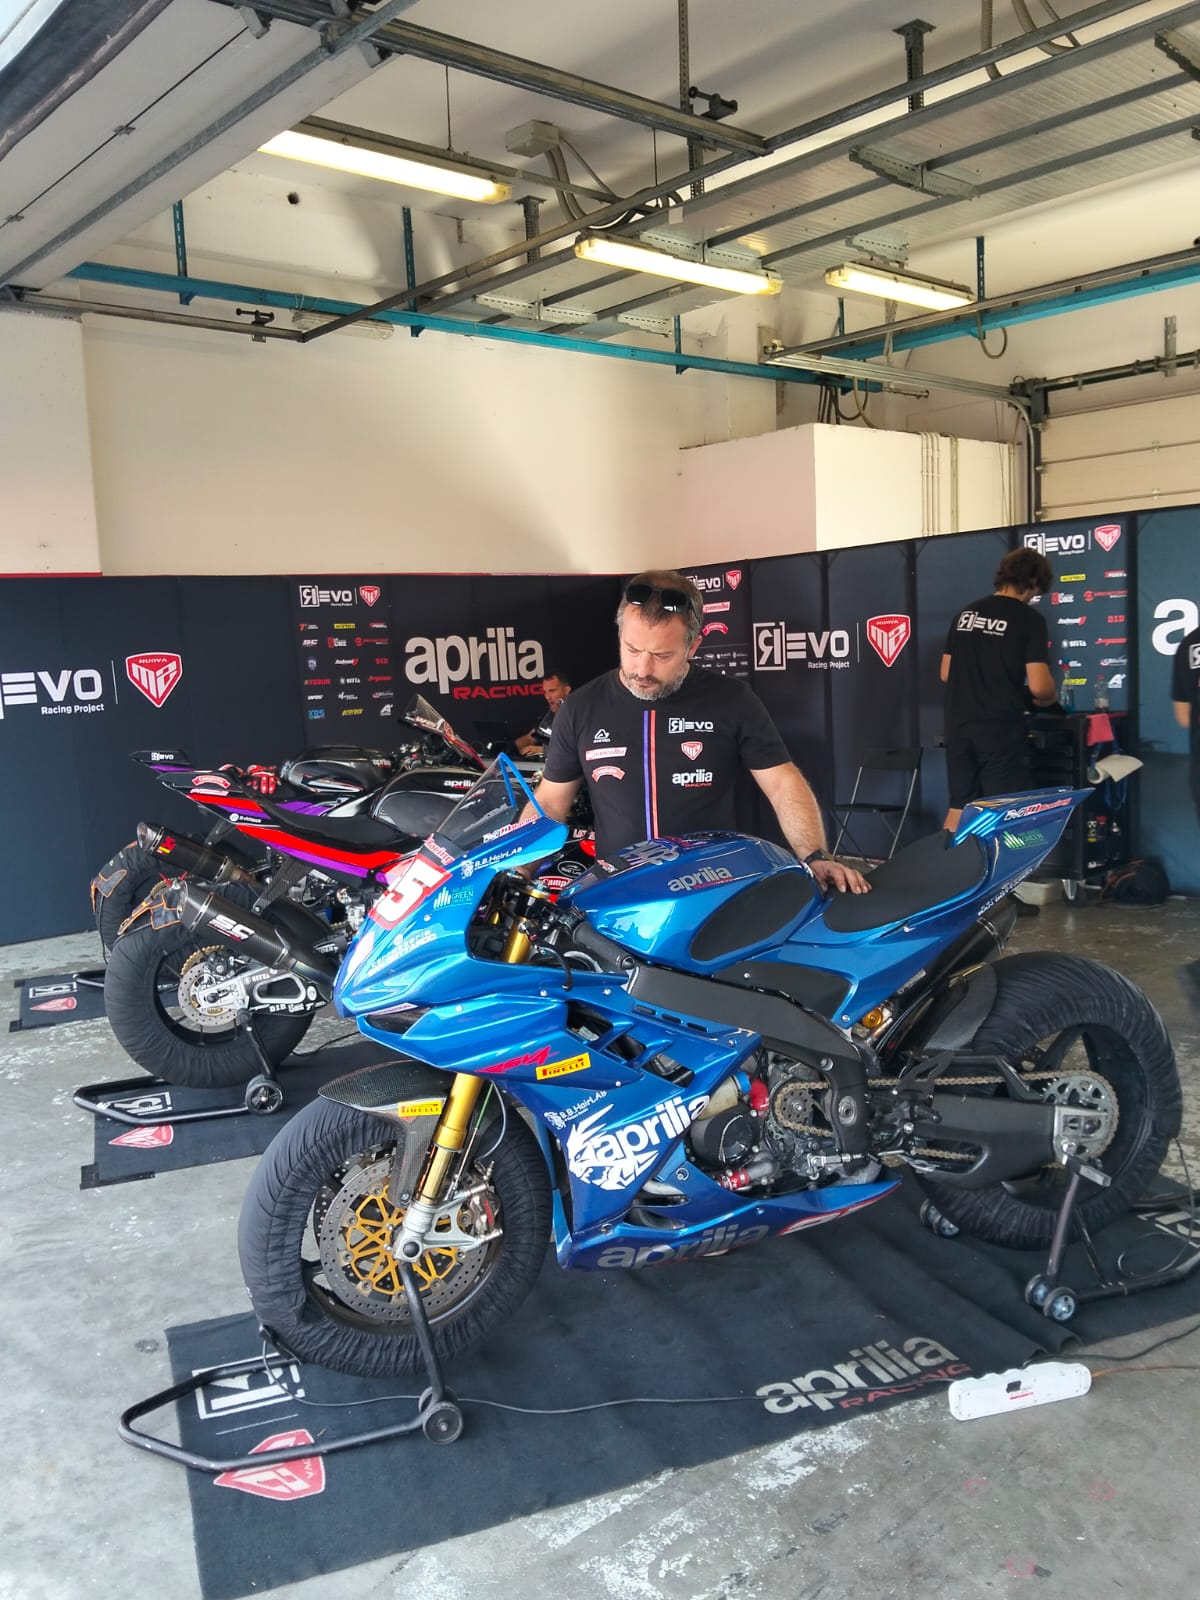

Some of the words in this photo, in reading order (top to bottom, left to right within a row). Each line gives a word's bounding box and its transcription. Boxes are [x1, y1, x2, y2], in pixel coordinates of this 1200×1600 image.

[405, 627, 545, 694] aprilia
[829, 661, 850, 669] Project
[1, 669, 103, 706] EVO
[453, 683, 545, 700] RACING
[41, 704, 73, 715] Racing
[74, 703, 105, 714] Project
[672, 769, 713, 787] aprilia
[667, 866, 733, 892] aprilia
[541, 1058, 585, 1076] PIRELLI
[401, 1103, 440, 1113] PIRELLI
[598, 1095, 711, 1166] aprilia
[597, 1224, 772, 1269] aprilia
[755, 1337, 959, 1414] aprilia
[840, 1363, 973, 1409] RACNG
